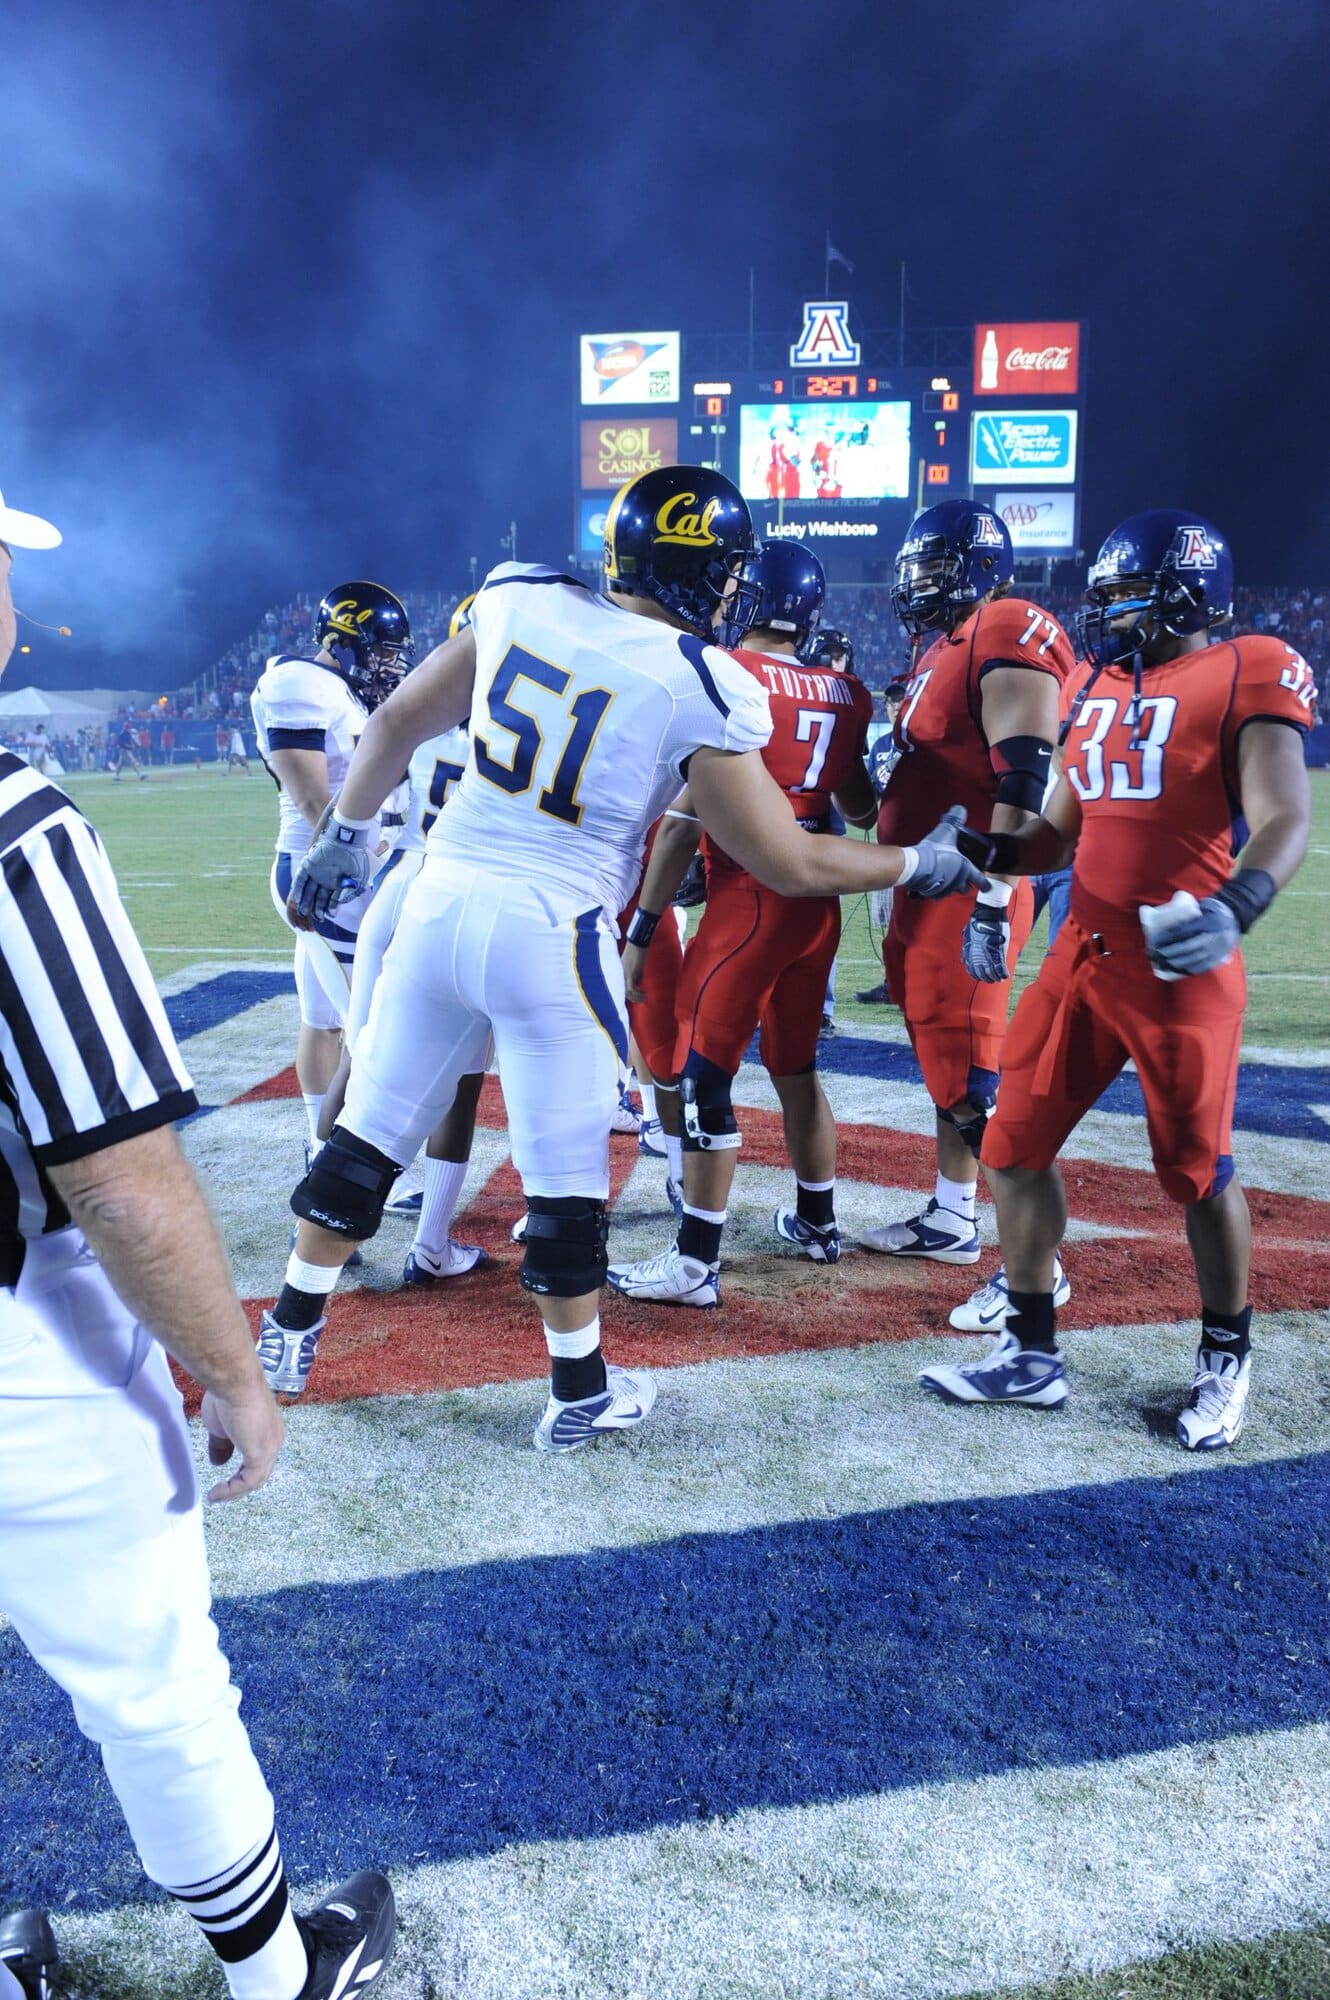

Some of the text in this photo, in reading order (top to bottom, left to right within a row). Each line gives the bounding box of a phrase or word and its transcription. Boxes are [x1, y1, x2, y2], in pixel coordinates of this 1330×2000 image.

[790, 301, 860, 367] A
[807, 375, 857, 396] 2:27
[943, 393, 959, 411] 0
[707, 398, 722, 416] 0
[599, 427, 662, 460] SOL
[1000, 420, 1050, 436] Tucson
[1004, 434, 1062, 449] Electric
[1008, 448, 1061, 463] Power
[653, 492, 722, 547] Cal
[766, 521, 879, 540] Lucky Wishbone
[973, 513, 1004, 549] A
[1002, 504, 1037, 526] AAA
[1019, 529, 1068, 538] Insurance
[1175, 526, 1217, 570] A
[1016, 607, 1060, 657] 77
[761, 665, 854, 706] TUITAMA
[474, 640, 617, 827] 51
[1066, 696, 1178, 802] 33
[788, 708, 838, 793] 7
